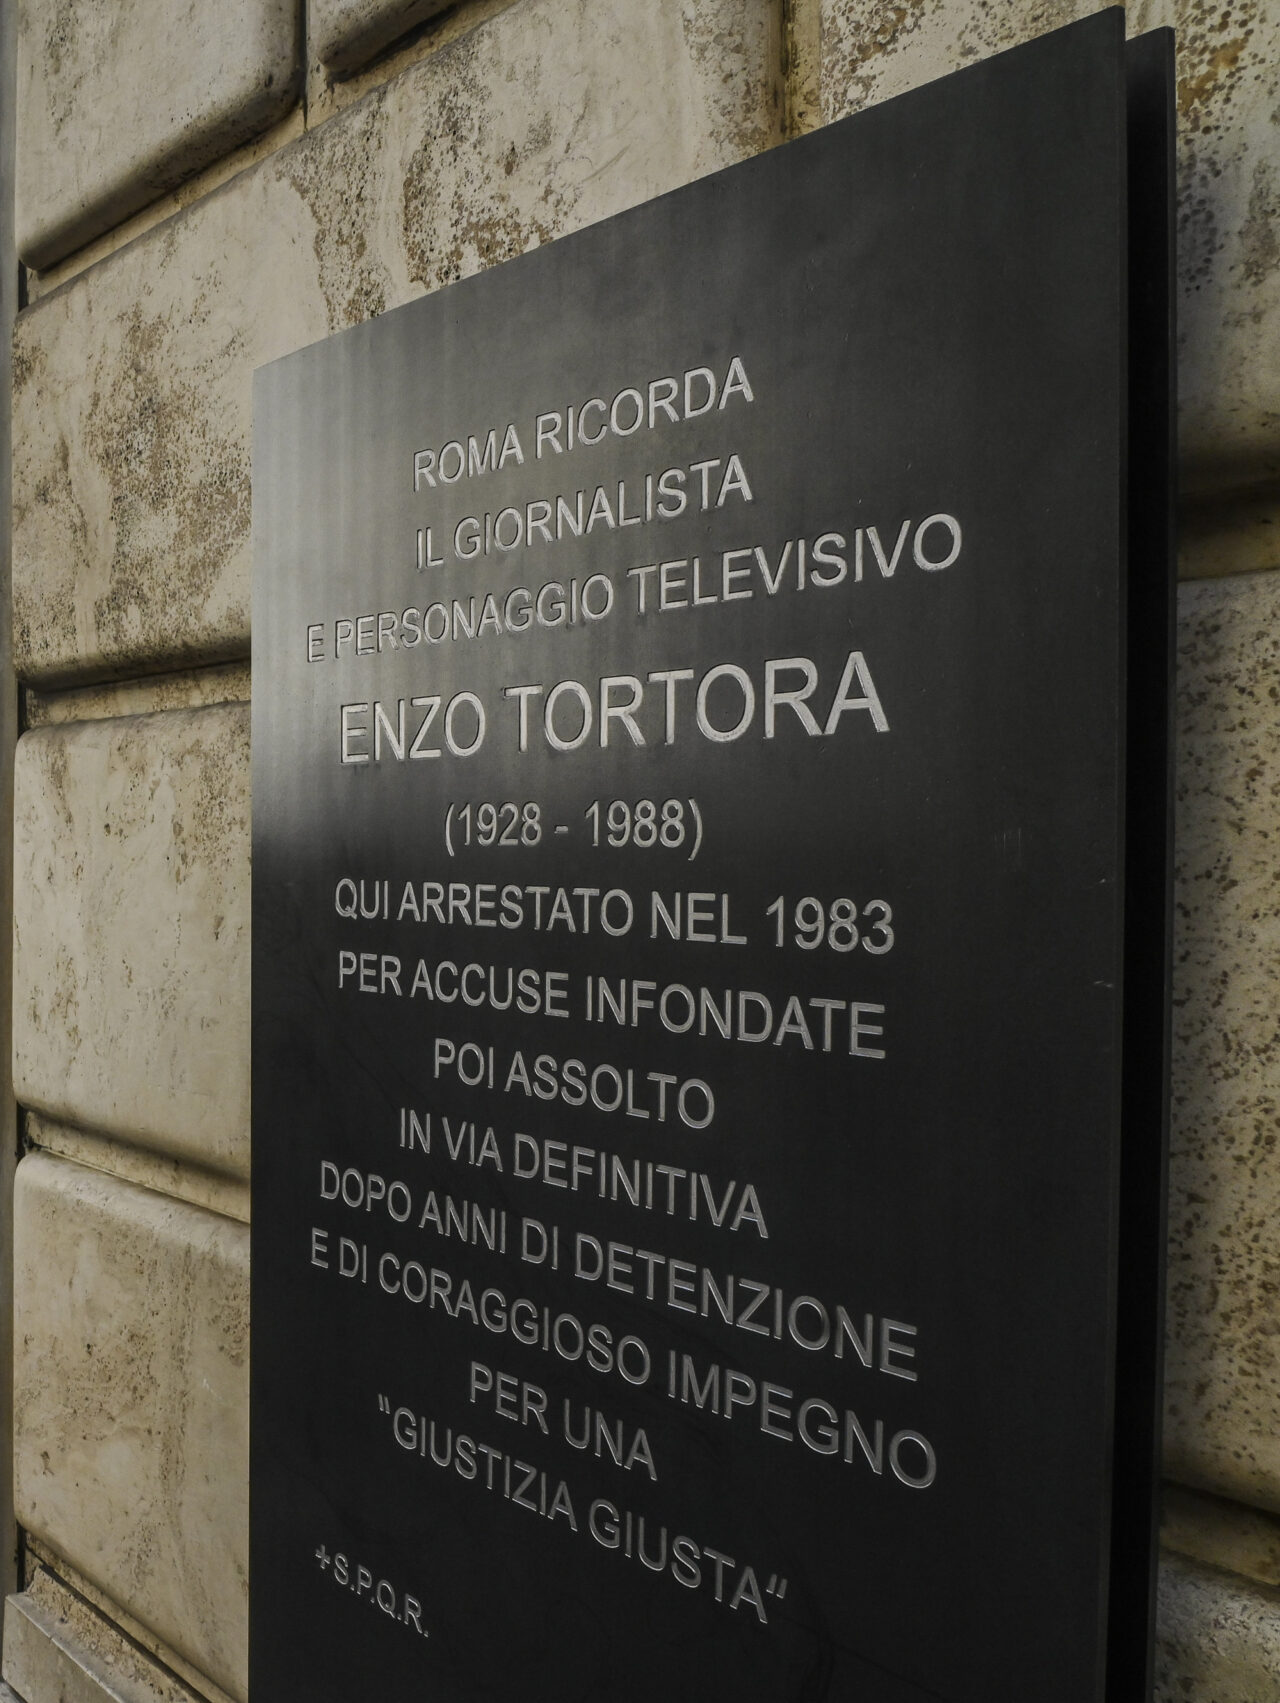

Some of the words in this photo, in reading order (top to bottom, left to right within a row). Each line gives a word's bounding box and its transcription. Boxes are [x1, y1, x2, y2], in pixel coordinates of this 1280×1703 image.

[414, 424, 525, 491] ROMA
[536, 356, 755, 459] RICORDA
[417, 528, 444, 569] IL
[454, 454, 753, 560] GIORNALISTA
[308, 625, 324, 662] E
[336, 574, 615, 654] PERSONAGGIO
[626, 513, 962, 613] TELEVISIVO
[342, 691, 486, 764] ENZO
[505, 650, 891, 752] TORTORA
[445, 802, 542, 857] (1928
[585, 798, 703, 861] 1988)
[334, 878, 389, 921] QUI
[396, 881, 634, 937] ARRESTATO
[649, 890, 748, 945] NEL
[765, 895, 895, 955] 1983
[338, 950, 403, 997] PER
[409, 958, 570, 1018] ACCUSE
[585, 975, 886, 1060] INFONDATE
[433, 1037, 494, 1089] POI
[503, 1050, 715, 1130] ASSOLTO
[399, 1107, 431, 1155] IN
[441, 1116, 504, 1173] VIA
[512, 1132, 769, 1239] DEFINITIVA
[319, 1160, 412, 1223] DOPO
[417, 1190, 506, 1254] ANNI
[520, 1217, 559, 1271] DI
[574, 1232, 918, 1382] DETENZIONE
[310, 1227, 329, 1269] E
[338, 1236, 367, 1284] DI
[378, 1252, 651, 1385] CORAGGIOSO
[667, 1350, 937, 1489] IMPEGNO
[469, 1360, 550, 1435] PER
[564, 1402, 658, 1482] UNA
